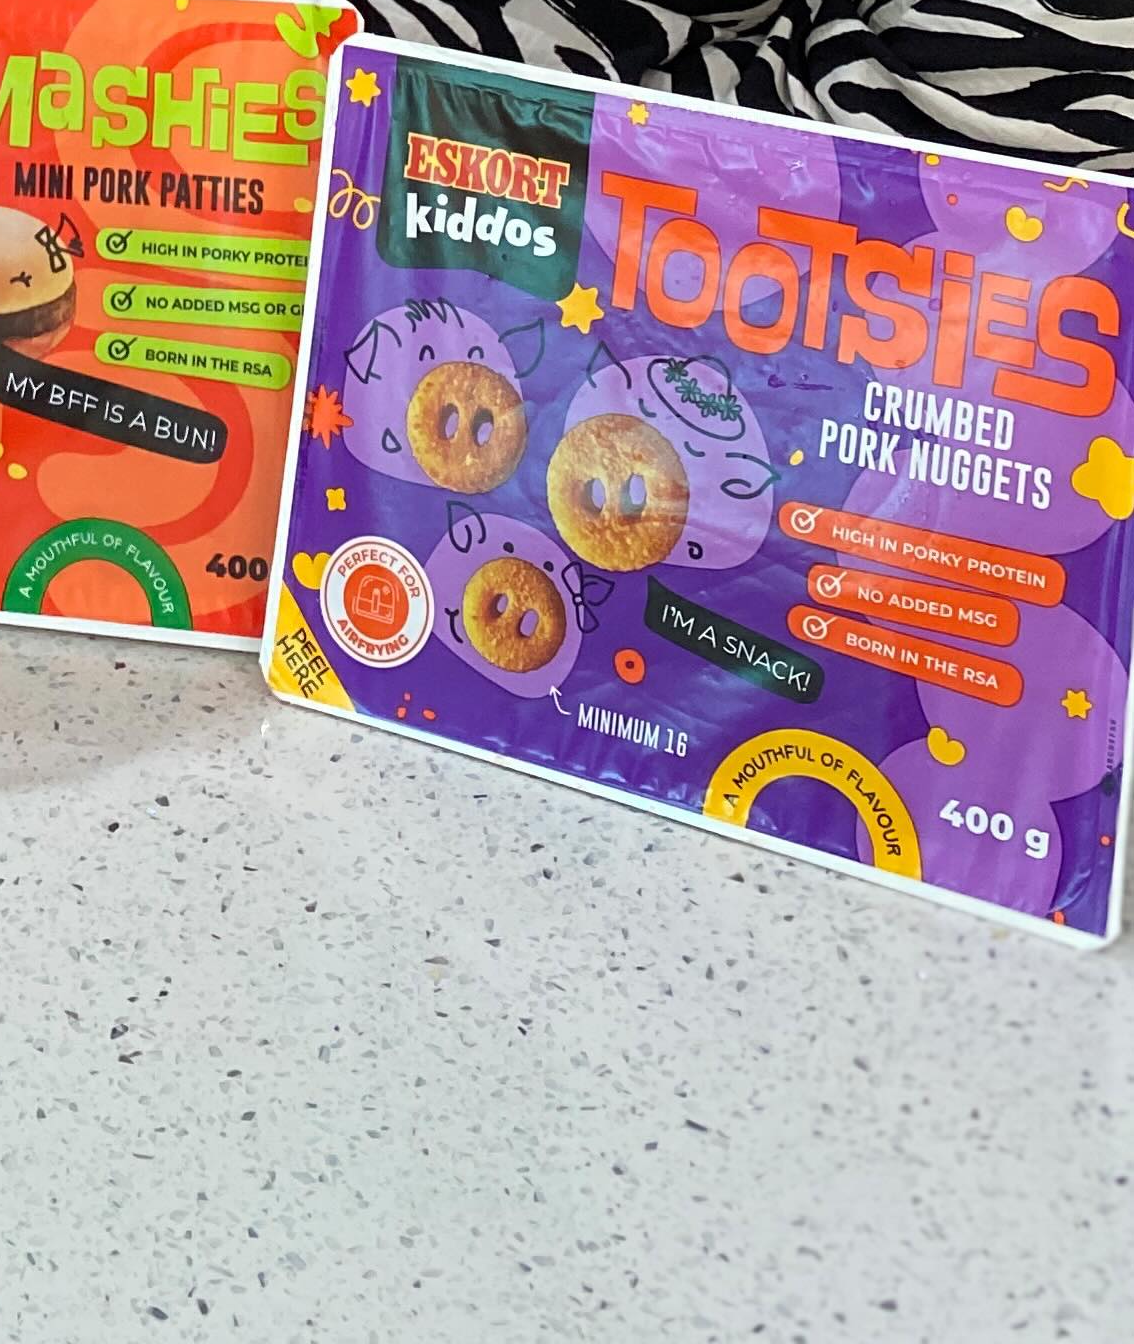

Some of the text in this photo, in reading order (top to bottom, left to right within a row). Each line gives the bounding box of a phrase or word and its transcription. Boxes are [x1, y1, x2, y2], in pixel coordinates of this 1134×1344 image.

[14, 162, 264, 215] MINI PORK PATTIES
[404, 132, 570, 209] ESKORT
[142, 242, 309, 267] HIGH IN PORKY PROTEI
[406, 193, 557, 257] kiddos
[146, 297, 168, 309] NO
[172, 299, 224, 312] ADDED
[229, 302, 260, 314] MSG
[264, 303, 286, 315] OR
[145, 349, 272, 377] BORN IN THE RSA
[6, 372, 216, 452] MY BFF IS A BUN!
[863, 381, 1015, 451] CRUMBED
[819, 418, 1052, 510] PORK NUGGETS
[18, 532, 175, 614] A MOUTHFUL OF FLAVOUR
[206, 553, 268, 581] 400
[337, 549, 421, 599] PERFECT FOR
[832, 526, 1046, 589] HIGH IN PORKY PROTEIN
[857, 587, 997, 627] NO ADDED MSG
[276, 634, 319, 698] HERE
[292, 627, 329, 685] PEEL
[337, 618, 409, 656] AIRFRYING
[662, 604, 812, 692] I'M A SNACK!
[845, 632, 999, 689] BORN IN THE RSA
[578, 703, 688, 758] MINIMUM 16
[723, 745, 901, 856] A MOUTHFUL OF FLAVOUR
[939, 799, 1050, 859] 400 g
